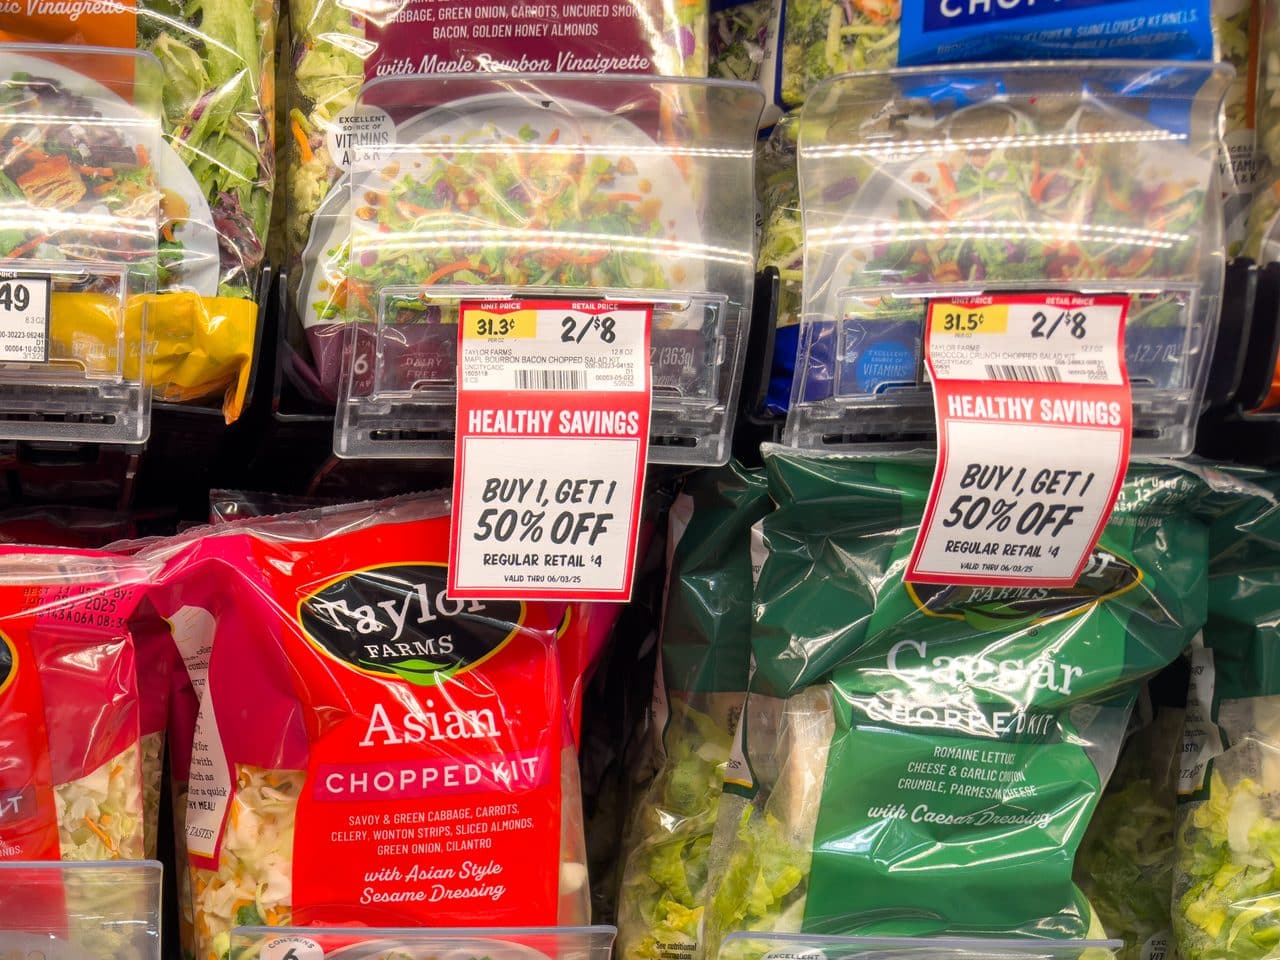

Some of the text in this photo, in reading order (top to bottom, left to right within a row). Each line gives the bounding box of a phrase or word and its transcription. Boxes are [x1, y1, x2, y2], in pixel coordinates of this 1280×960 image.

[27, 0, 124, 20] Vinaigrette
[433, 23, 598, 41] BACON, GOLDEN HONEY ALMONDS
[377, 53, 650, 77] with Maple Bourbon Vinaigrette
[477, 318, 515, 335] 31.3¢
[561, 316, 616, 344] 2/$8
[944, 314, 984, 331] 31.5¢
[1031, 311, 1086, 339] 2/$8
[469, 410, 639, 434] HEALTHY SAVINGS
[948, 395, 1121, 425] HEALTHY SAVINGS
[960, 464, 1094, 496] BUY 1, GET 1
[482, 479, 617, 506] BUY 1, GET 1
[474, 510, 613, 545] 50% OFF
[942, 496, 1082, 537] 50% OFF
[483, 554, 602, 567] REGULAR RETAIL $4
[547, 575, 581, 583] 06/03/25
[364, 636, 453, 660] FARMS
[887, 640, 1083, 696] Caesar
[359, 699, 500, 747] Asian
[326, 757, 539, 793] CHOPPED KIT
[364, 861, 502, 883] with Asian Style
[360, 883, 505, 905] Sesame Dressing
